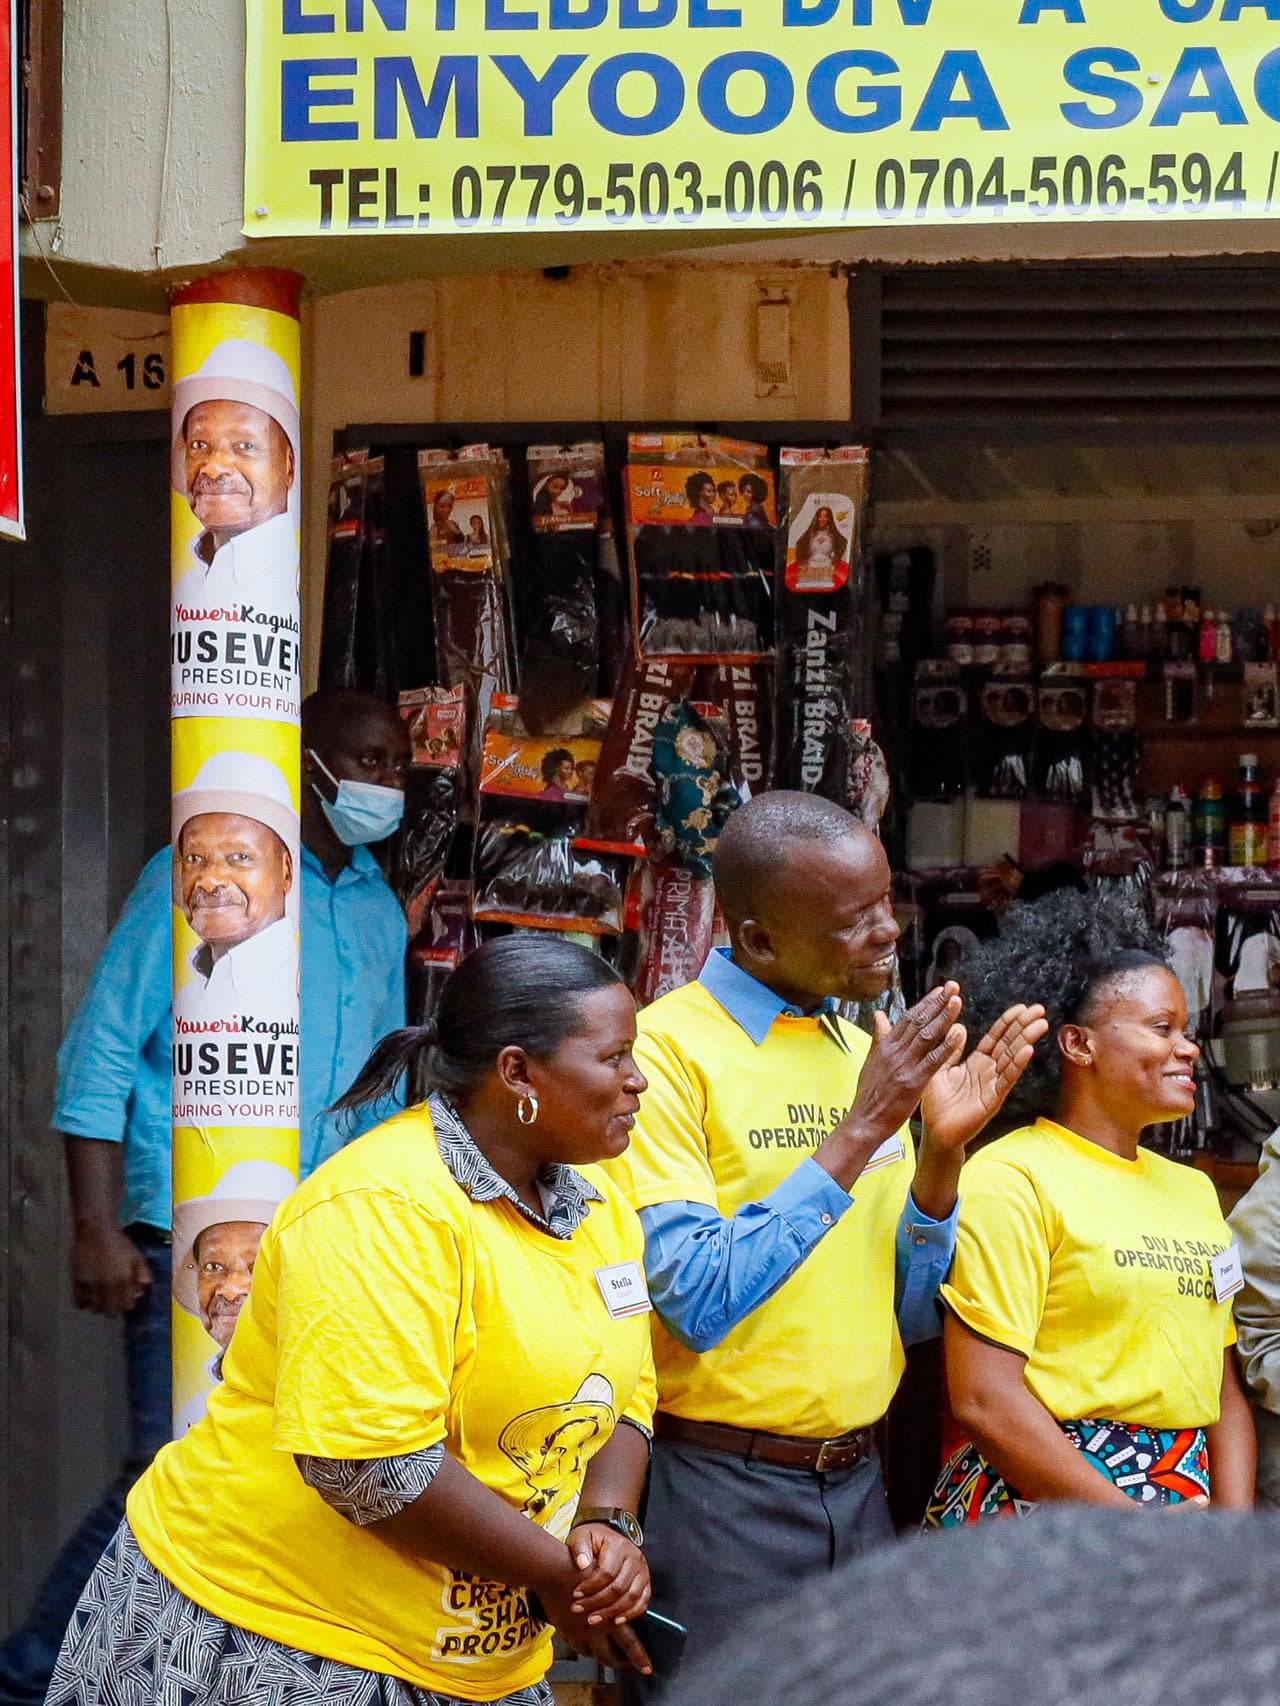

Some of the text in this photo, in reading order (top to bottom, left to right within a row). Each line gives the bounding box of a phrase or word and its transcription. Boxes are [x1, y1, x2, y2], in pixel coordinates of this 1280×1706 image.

[280, 49, 1010, 142] EMYOOGA
[309, 167, 431, 230] TEL:
[452, 159, 823, 228] 0779-503-006
[875, 151, 1247, 219] 0704-506-594
[71, 351, 165, 390] A 16
[172, 630, 300, 675] USEVE
[182, 668, 292, 692] PRESIDENT
[224, 693, 272, 710] YOUR
[801, 608, 838, 785] Zanzi BRAID
[626, 693, 664, 773] BRAID
[735, 700, 763, 781] BRAID
[172, 1042, 300, 1077] USEVE
[183, 1079, 294, 1097] PRESIDENT
[227, 1103, 274, 1117] YOUR
[787, 1103, 815, 1125] DIV
[817, 1105, 826, 1126] A
[1141, 1235, 1169, 1252] DIV
[1173, 1239, 1186, 1255] A
[1113, 1248, 1204, 1277] OPERATORS
[610, 1276, 633, 1290] Stella
[1177, 1276, 1215, 1300] SACC
[478, 1595, 529, 1632] SHA
